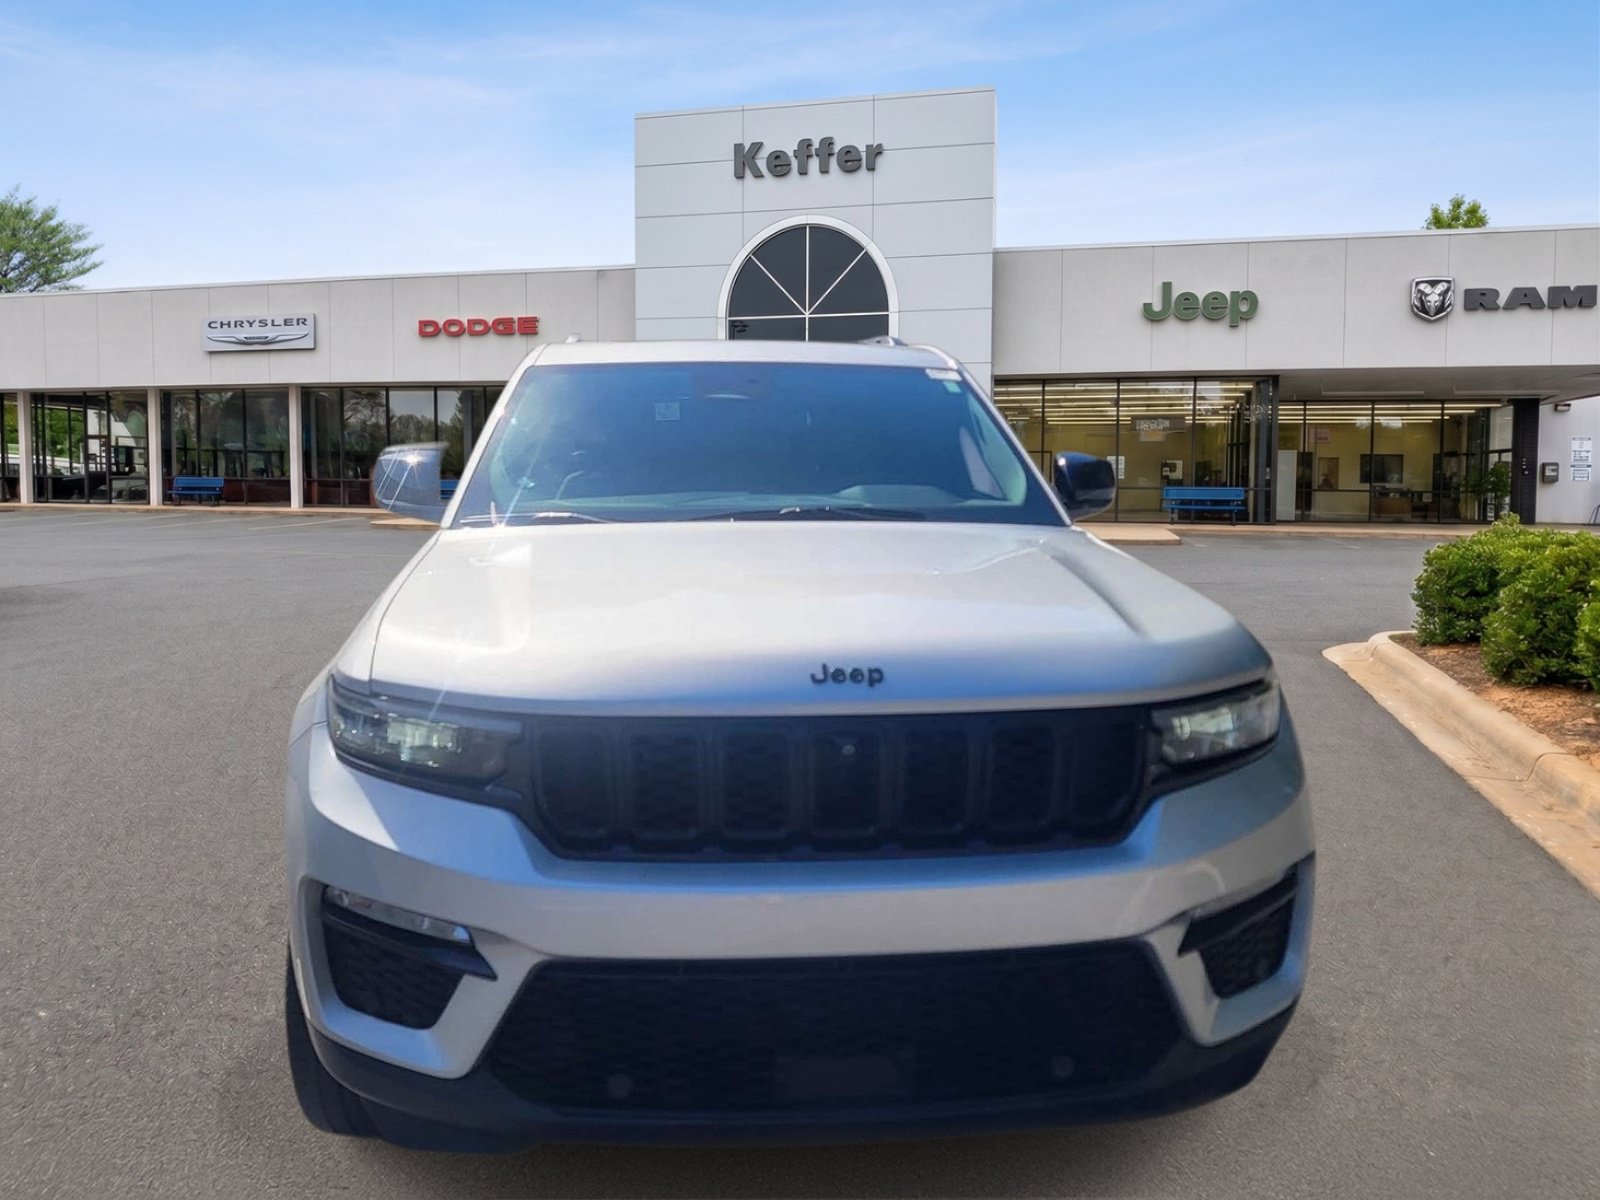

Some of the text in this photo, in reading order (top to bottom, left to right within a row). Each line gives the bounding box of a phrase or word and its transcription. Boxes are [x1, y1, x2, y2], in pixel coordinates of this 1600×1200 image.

[734, 137, 883, 179] Keffer
[1143, 281, 1259, 327] Jeep
[1464, 285, 1597, 311] RAM
[207, 317, 308, 330] CHRYSLER
[418, 316, 539, 337] DODGE
[810, 663, 884, 688] Jeep
